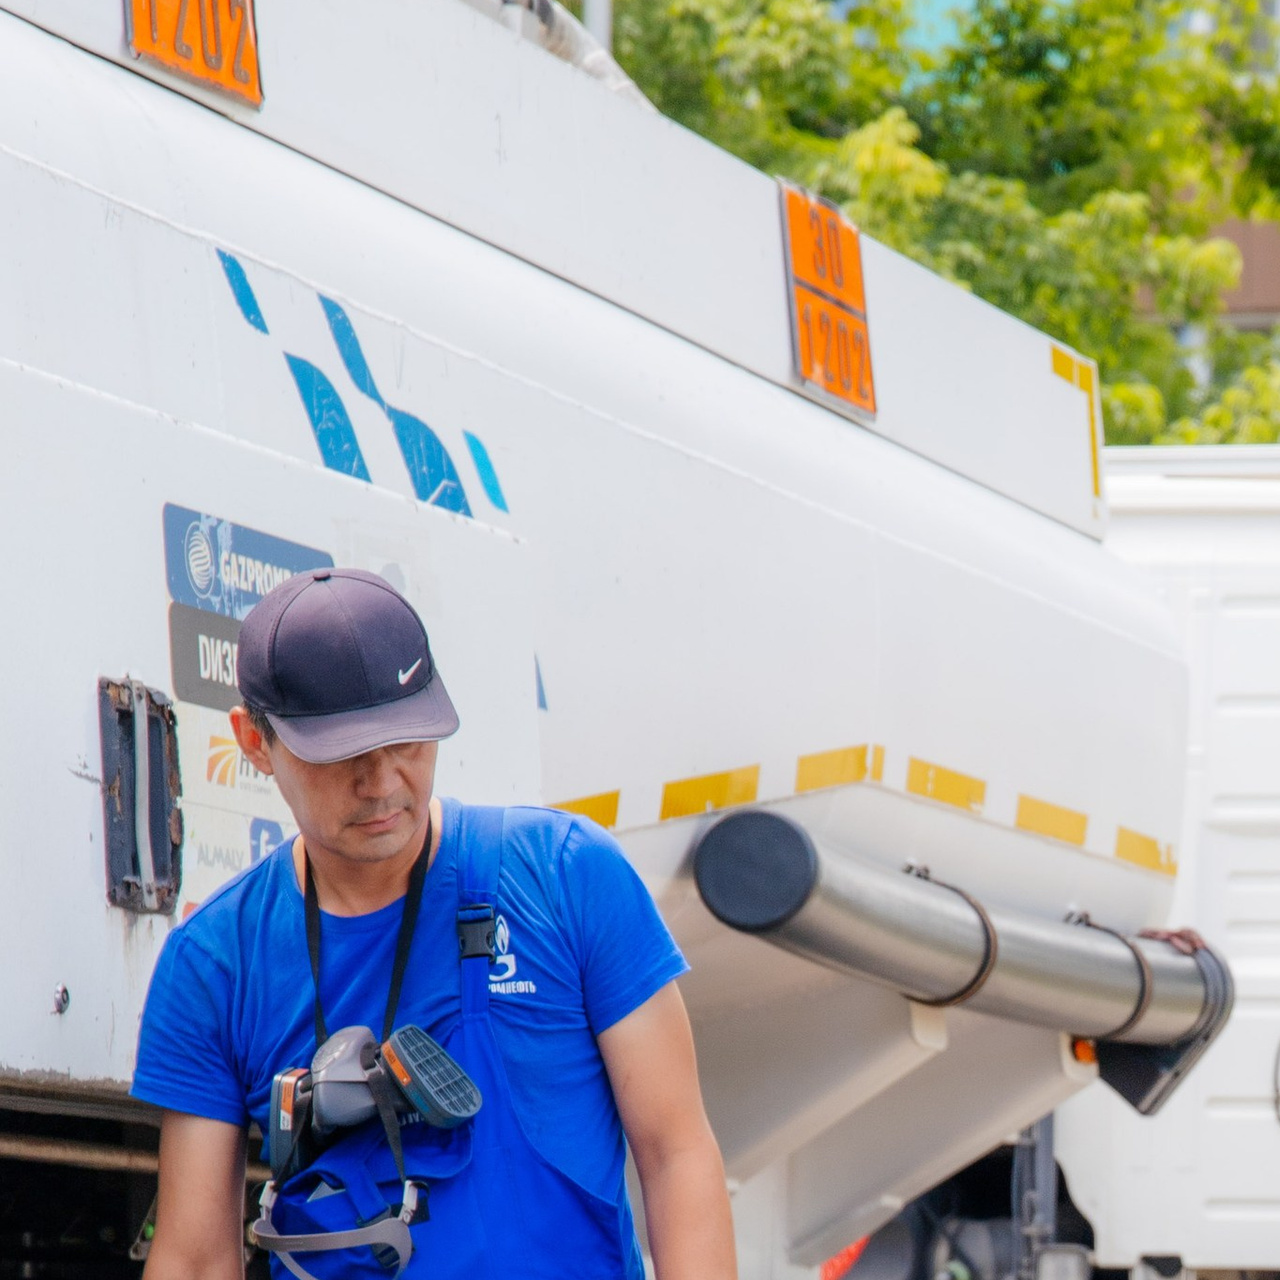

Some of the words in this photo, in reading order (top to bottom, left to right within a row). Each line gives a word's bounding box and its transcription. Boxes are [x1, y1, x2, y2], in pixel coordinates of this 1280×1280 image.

[810, 208, 844, 288] 30
[803, 302, 869, 399] 1202
[488, 980, 537, 994] ОМНЕФТЬ
